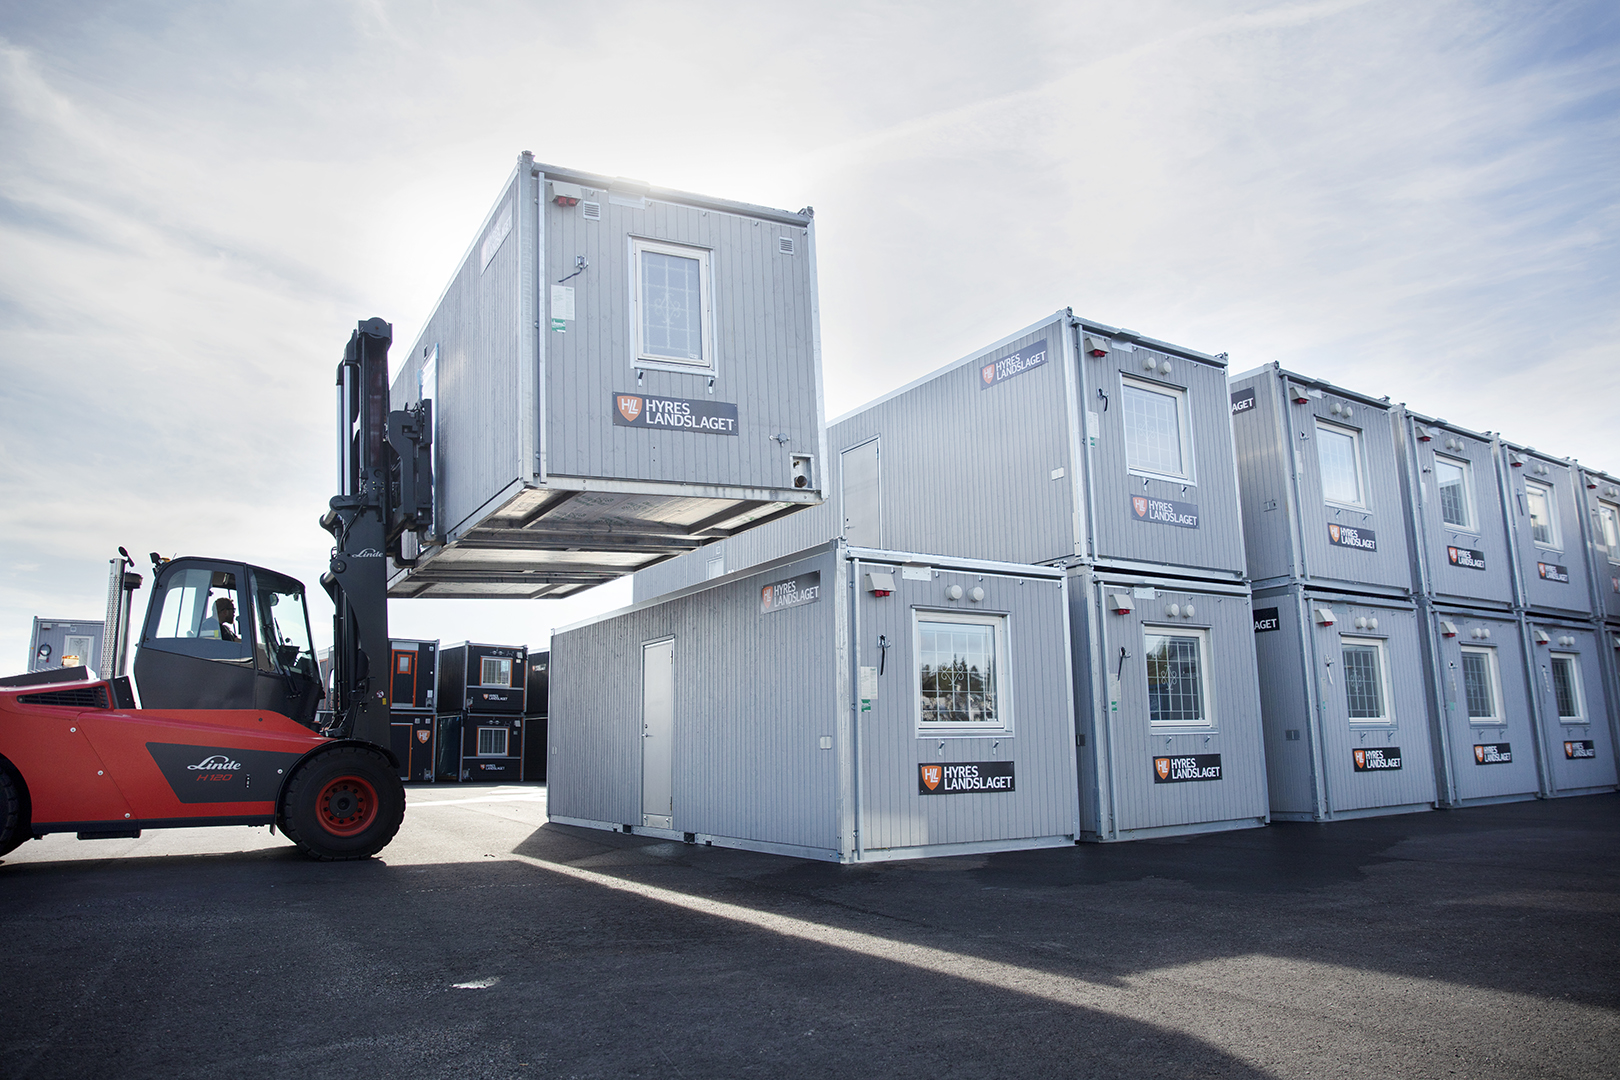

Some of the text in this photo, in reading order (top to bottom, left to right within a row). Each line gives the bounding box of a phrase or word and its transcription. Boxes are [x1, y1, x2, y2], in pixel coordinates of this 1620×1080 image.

[996, 353, 1020, 372] HYRES
[996, 350, 1046, 381] LANDSLAGET
[646, 399, 690, 415] HYRES
[646, 412, 735, 431] LANDSLAGET
[1148, 499, 1174, 513] HYRES
[1149, 509, 1198, 526] LANDSLAGET
[1340, 527, 1358, 538] HYRES
[1341, 535, 1375, 549] LANDSLAGET
[351, 547, 384, 559] Linde
[774, 580, 796, 597] HYRES
[774, 586, 820, 608] LANDSLAGET
[187, 754, 242, 770] Linde
[1365, 750, 1384, 760] HYRES
[1170, 758, 1196, 769] HYRES
[1366, 757, 1401, 769] LANDSLAGET
[943, 765, 979, 778] HYRES
[1171, 766, 1220, 779] LANDSLAGET
[944, 776, 1012, 790] LANDSLAGET
